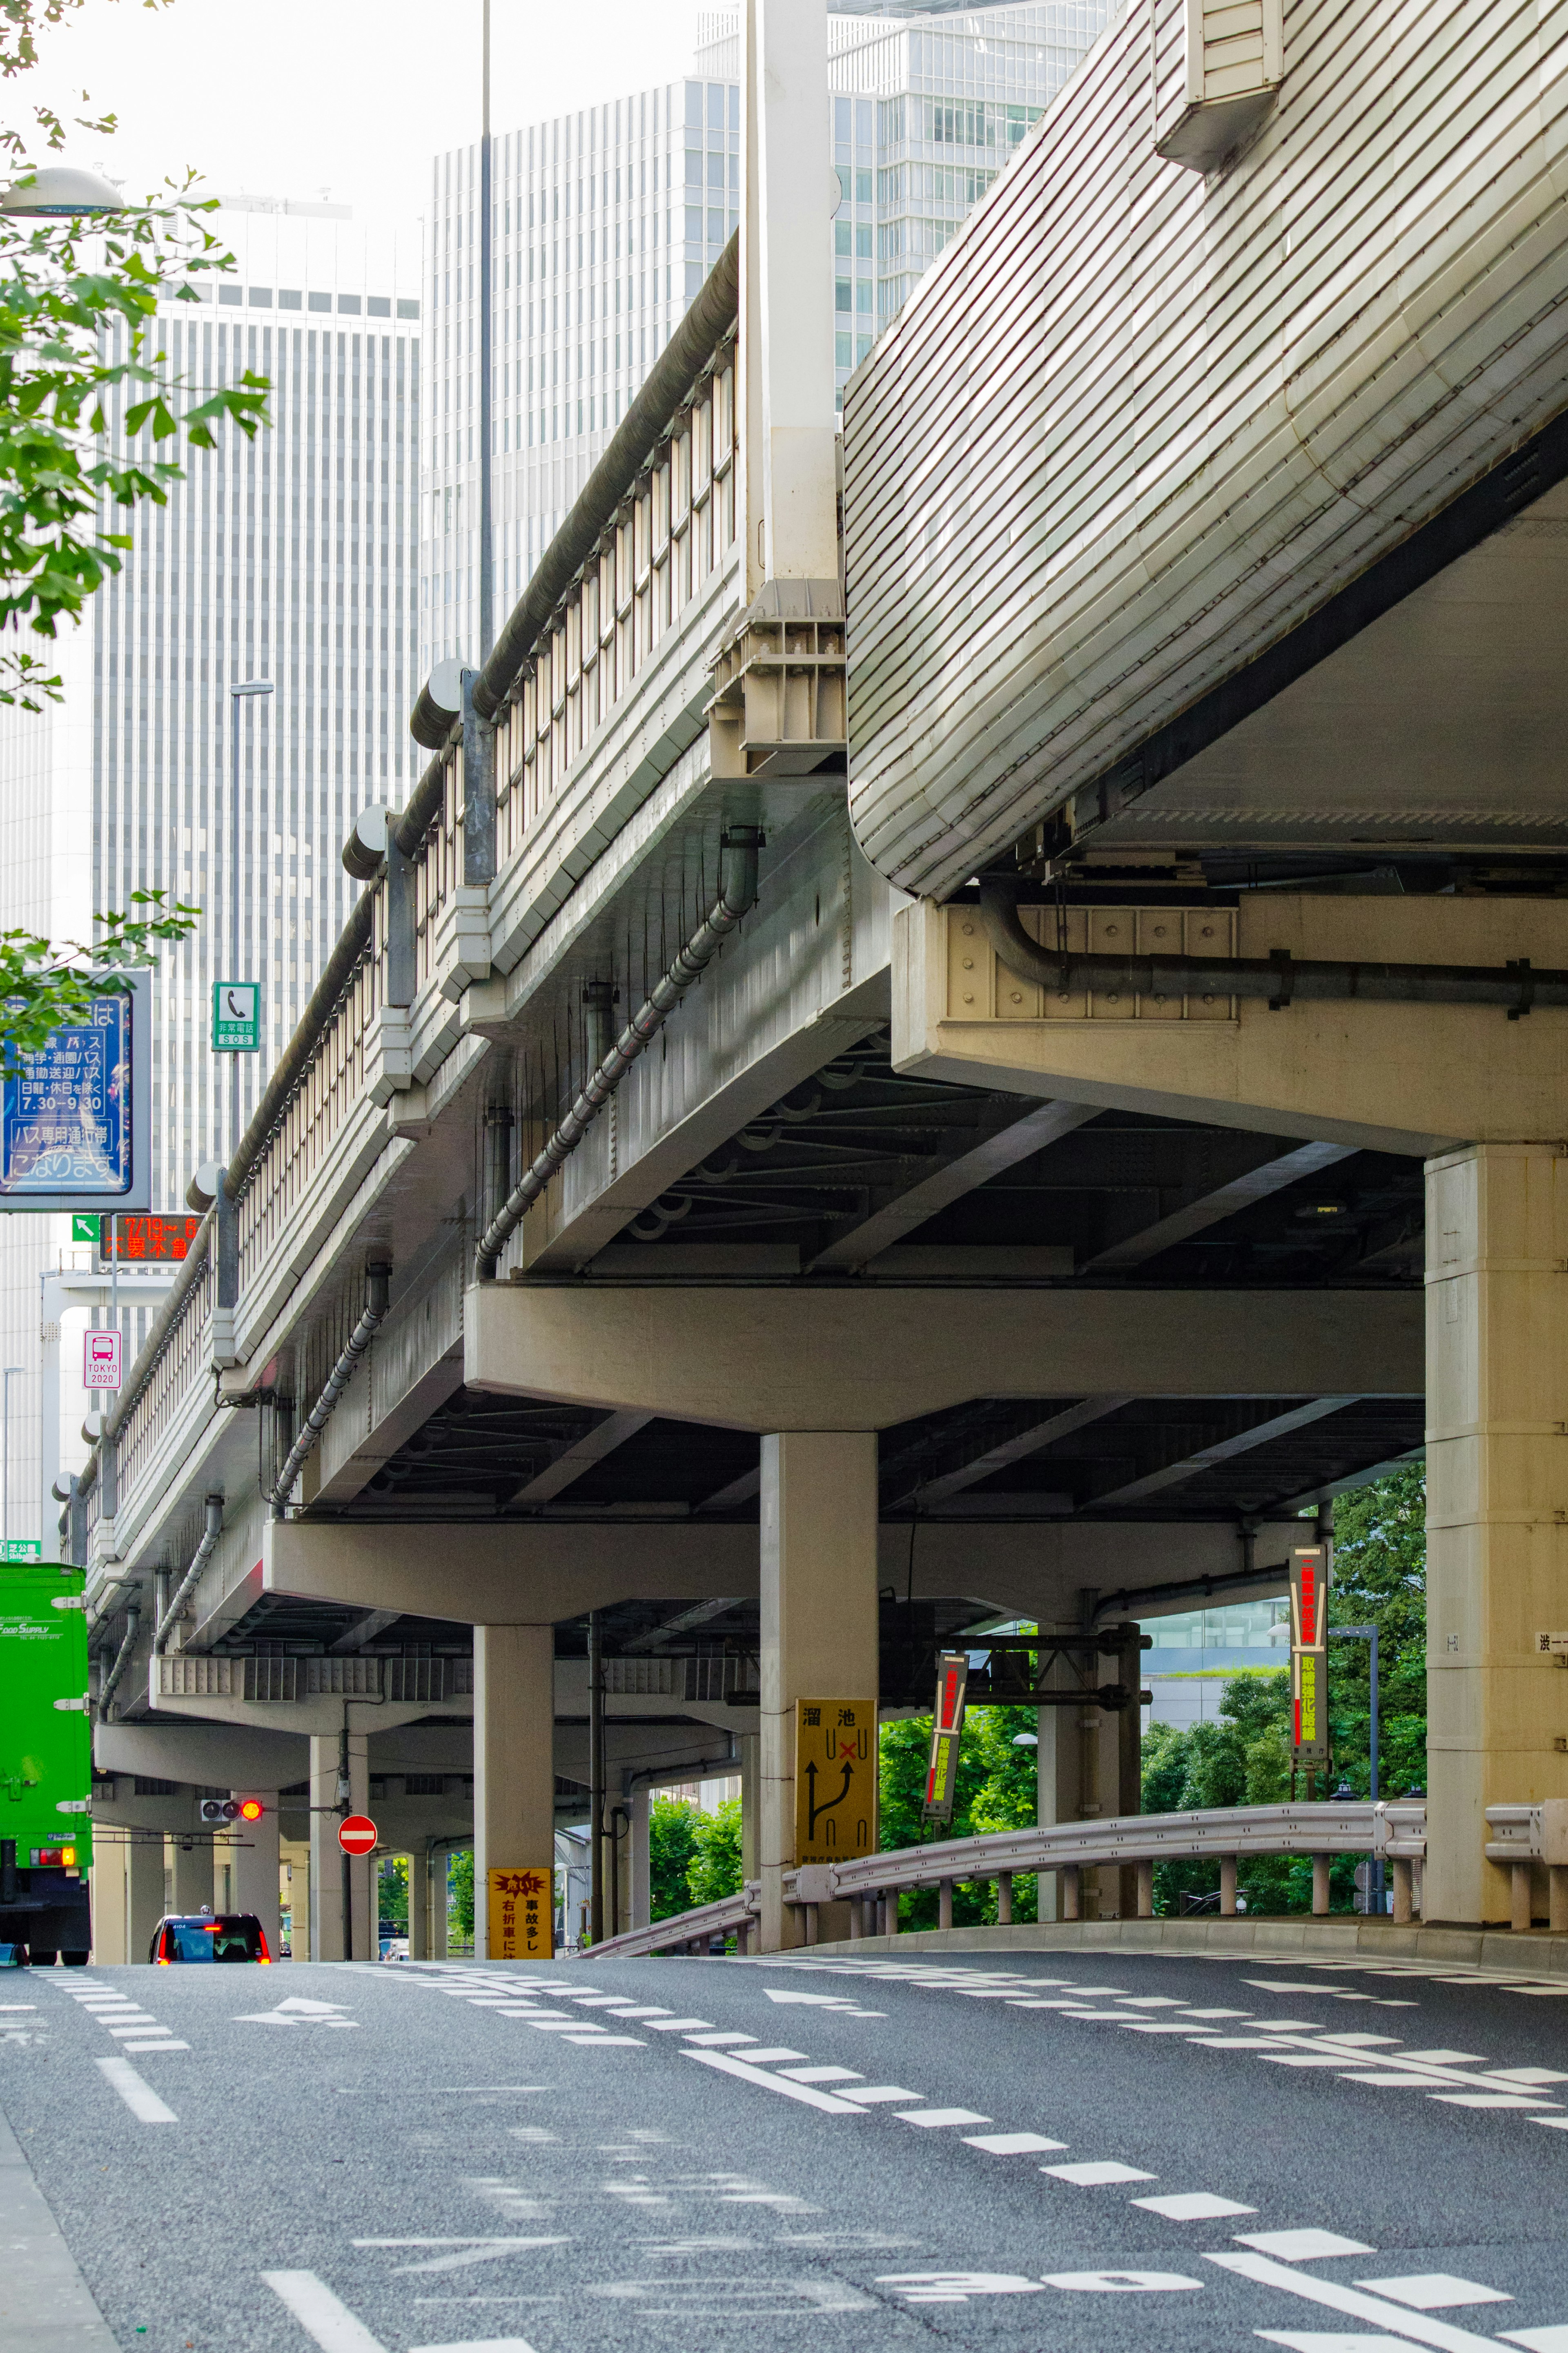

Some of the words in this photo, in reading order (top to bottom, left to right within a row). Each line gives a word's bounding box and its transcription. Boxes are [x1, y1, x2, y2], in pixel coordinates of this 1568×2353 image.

[219, 1023, 254, 1033] 非常電話
[223, 1035, 249, 1044] SOS
[22, 1067, 101, 1079] 通勤送迎バス
[22, 1082, 101, 1095] 日曜・休日を除く
[16, 1126, 107, 1144] バス専用通行帯
[9, 1153, 114, 1178] になります
[89, 1364, 117, 1372] TOKYO
[92, 1375, 113, 1383] 2020
[9, 1544, 36, 1552] 芝公園
[1302, 1657, 1316, 1741] 取締強化路線
[933, 1737, 951, 1801] 取締強化路線
[526, 1900, 539, 1951] 事故多し
